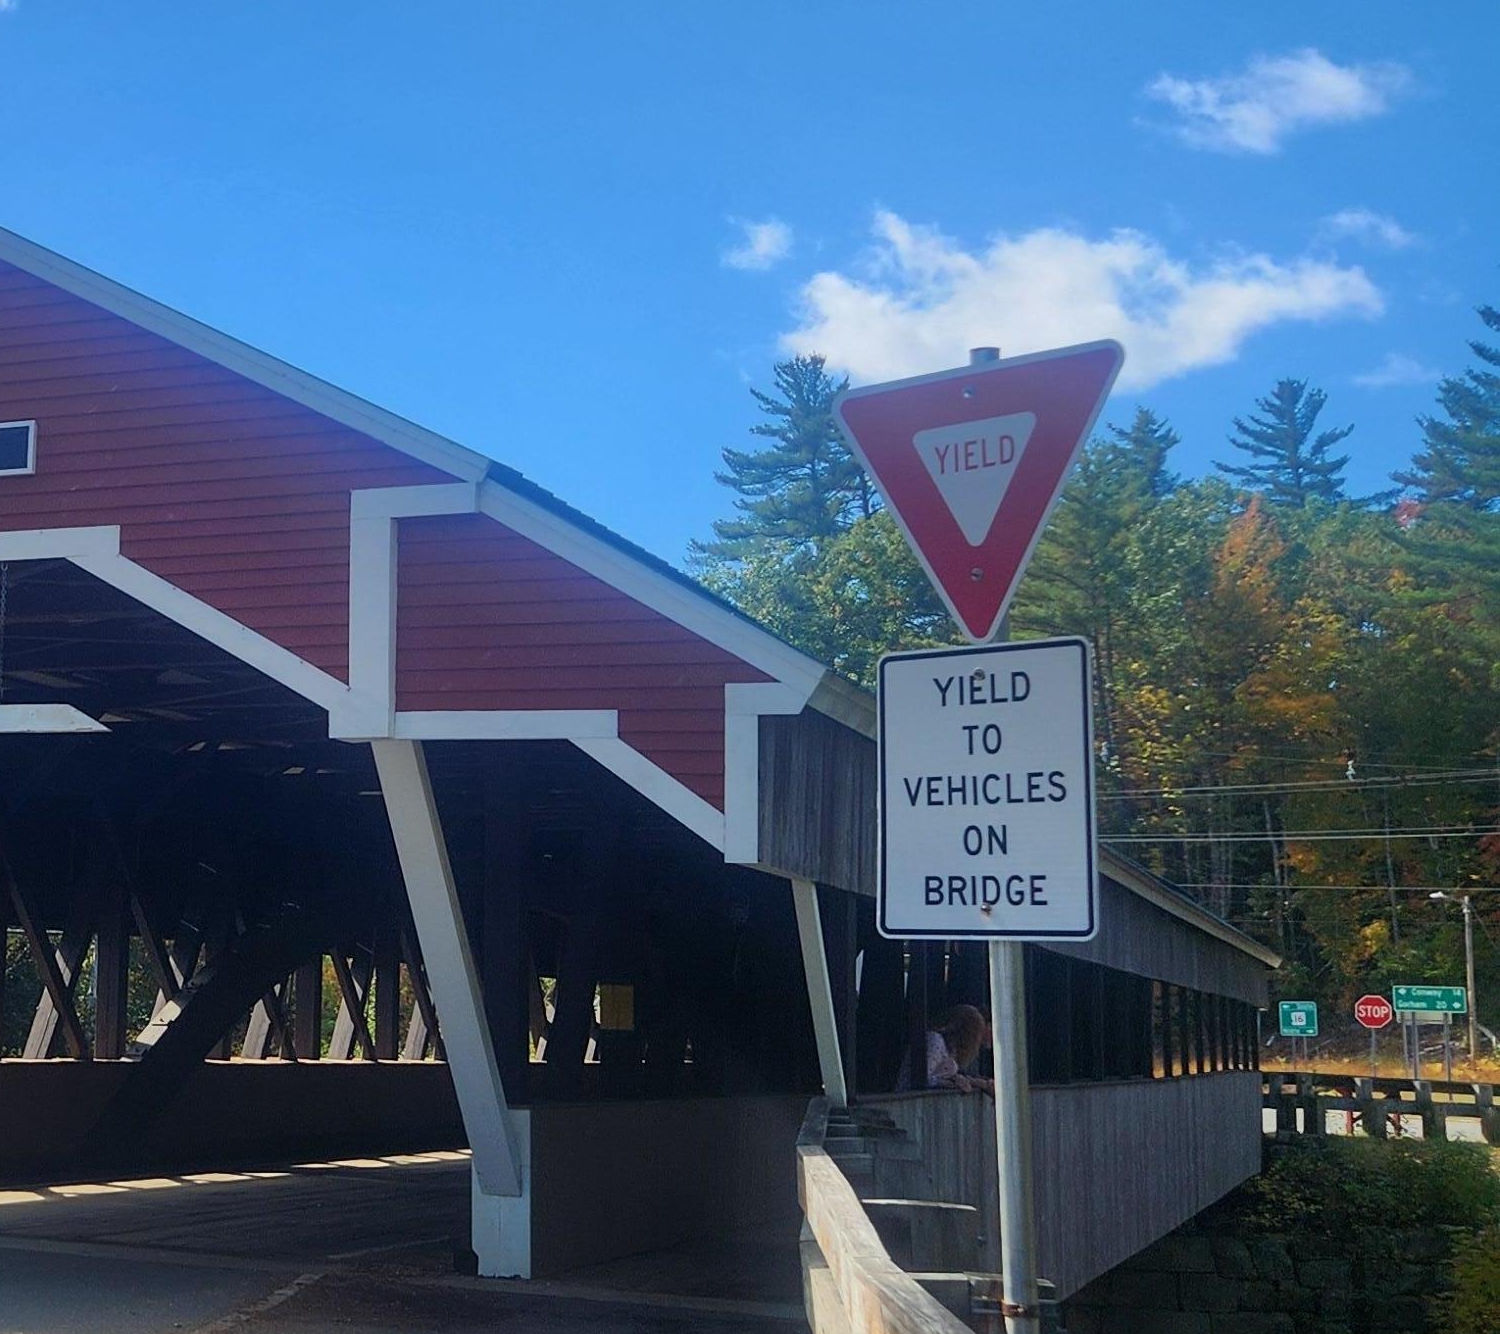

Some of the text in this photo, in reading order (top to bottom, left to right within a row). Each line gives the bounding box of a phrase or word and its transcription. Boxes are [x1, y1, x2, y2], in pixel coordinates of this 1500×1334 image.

[934, 434, 1015, 474] YIELD
[932, 670, 1031, 707] YIELD
[962, 723, 1002, 755] TO
[903, 770, 1068, 807] VEHICLES
[963, 824, 1008, 856] ON
[924, 874, 1049, 906] BRIDGE
[1294, 1015, 1305, 1023] 16
[1357, 1005, 1390, 1018] STOP
